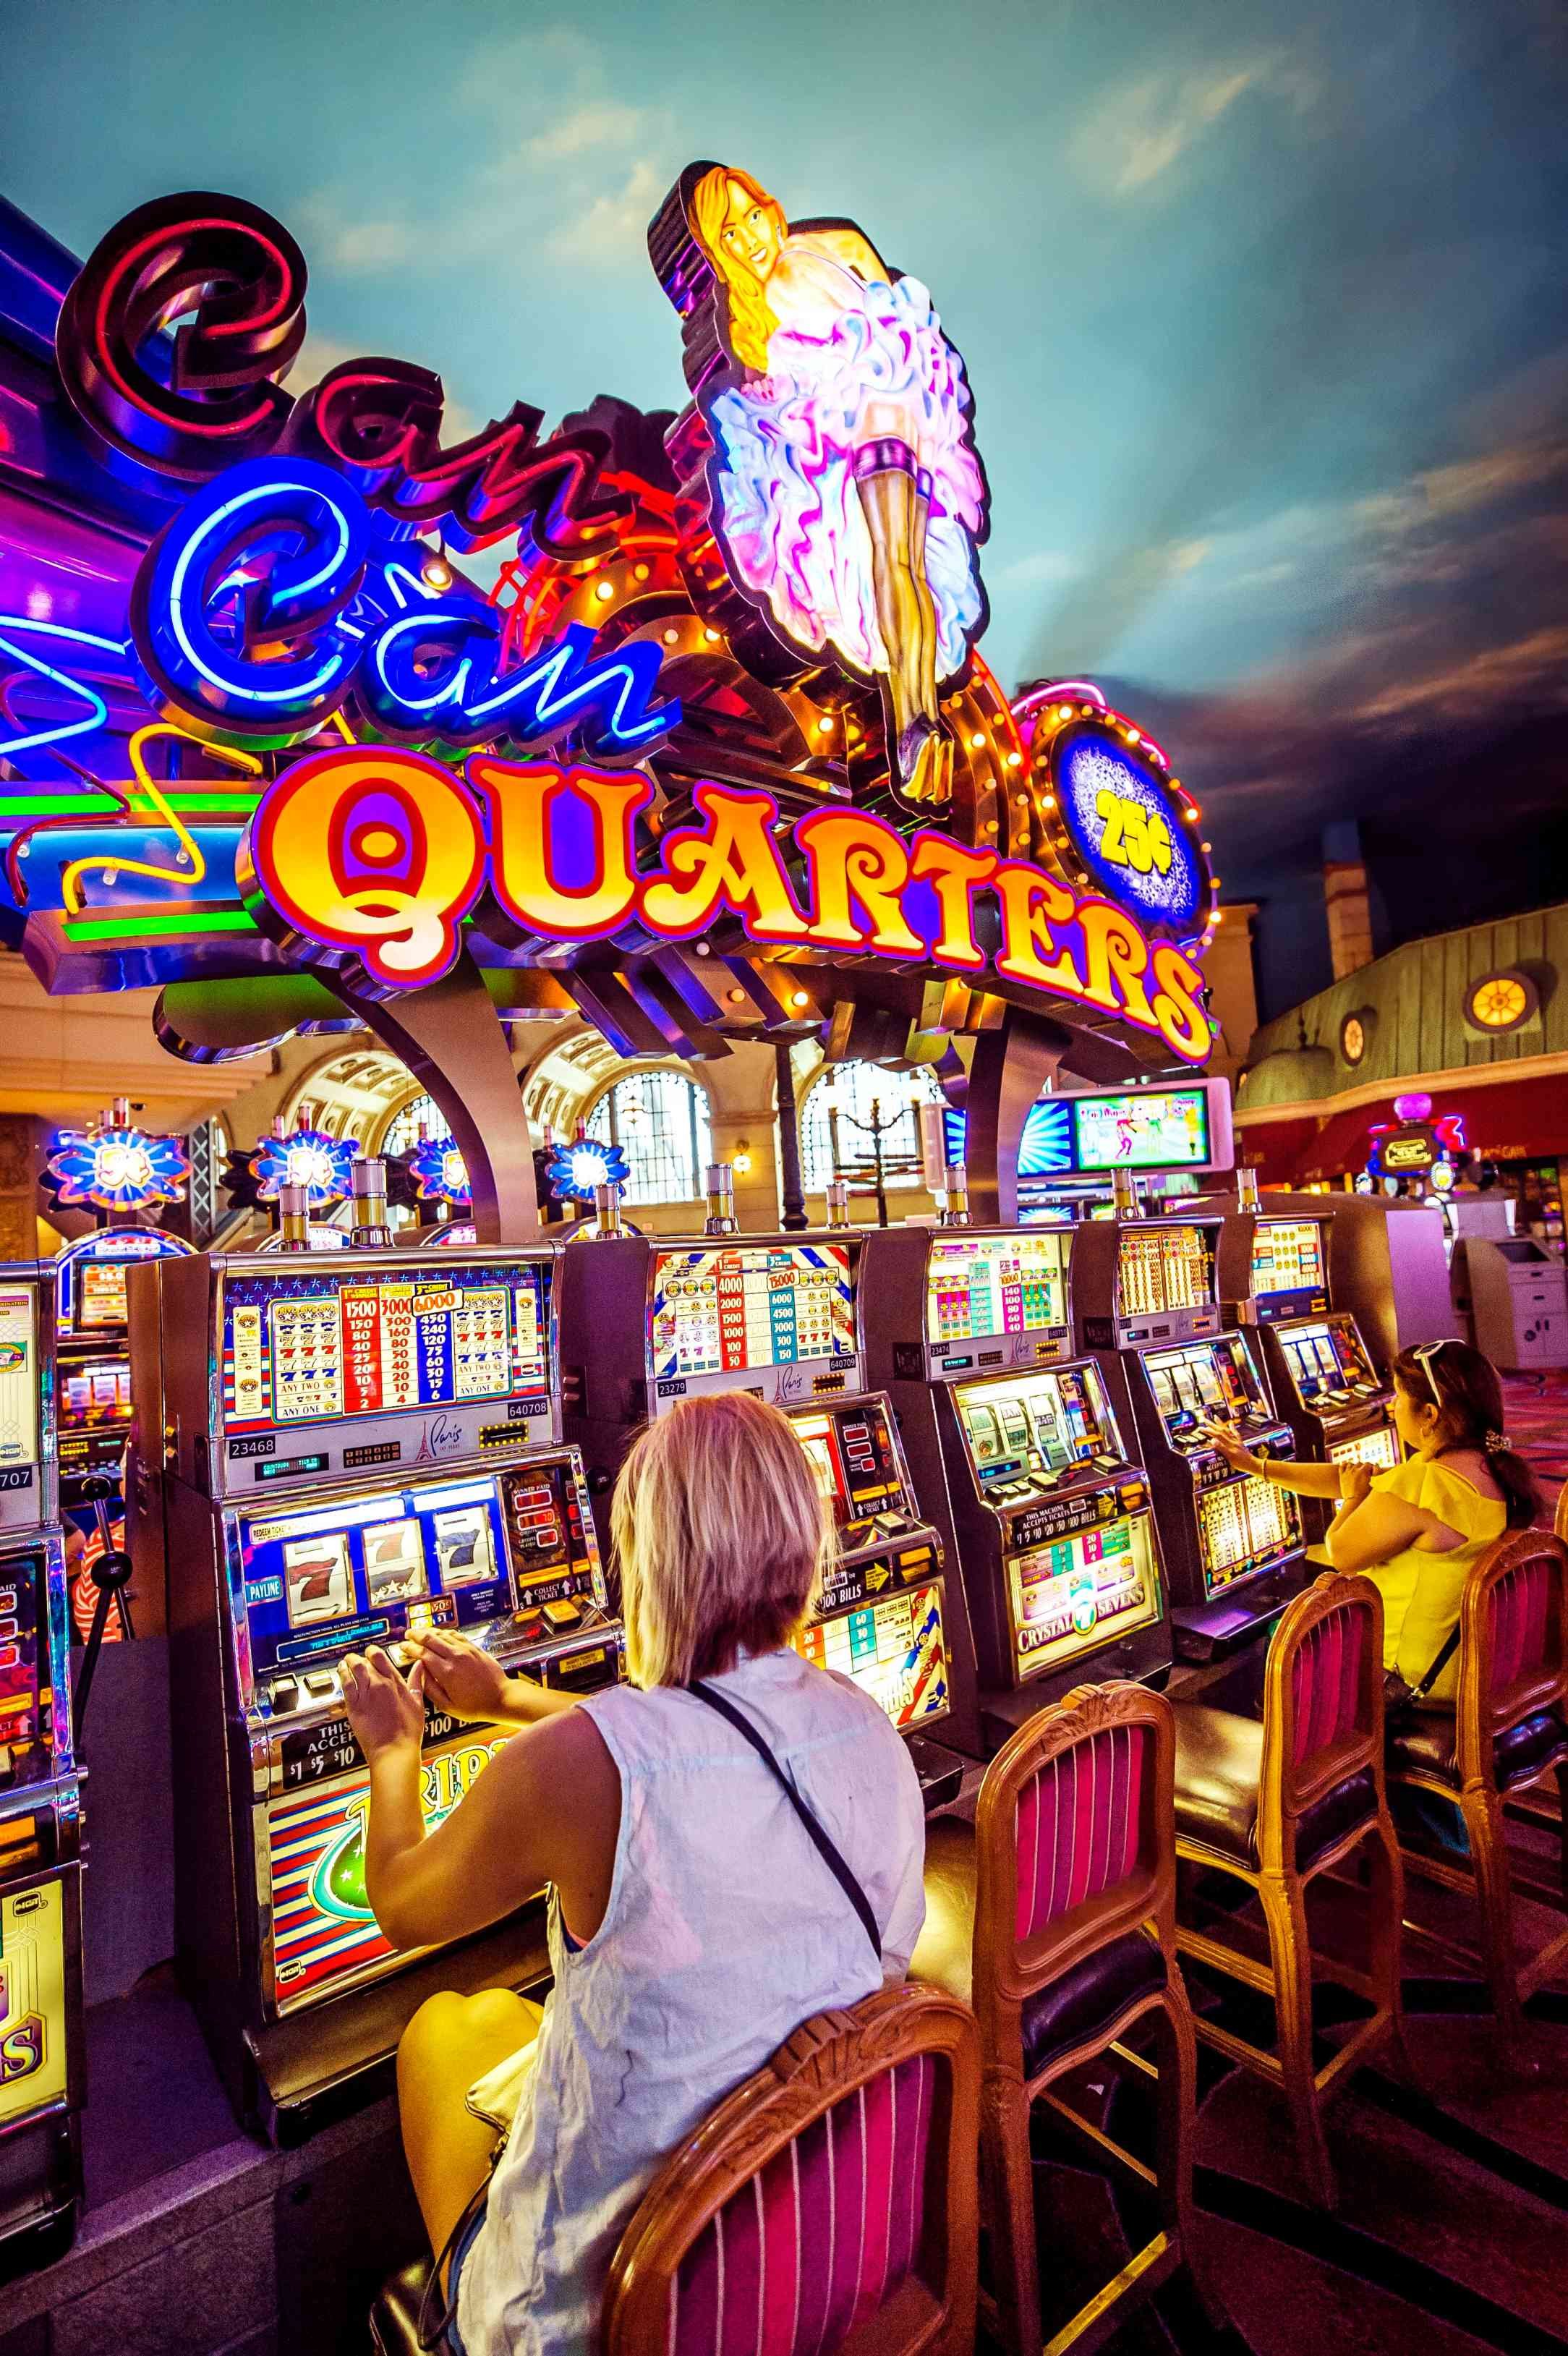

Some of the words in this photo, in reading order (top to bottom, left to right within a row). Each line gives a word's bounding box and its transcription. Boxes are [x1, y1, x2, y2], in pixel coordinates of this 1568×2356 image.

[56, 190, 636, 561] Can
[130, 456, 682, 752] Can
[1096, 788, 1172, 875] 25¢
[262, 749, 1211, 1063] QUARTERS
[719, 1277, 742, 1293] 4000
[414, 1293, 455, 1312] 6,000
[720, 1298, 741, 1309] 2000
[772, 1293, 792, 1304] 6000
[346, 1301, 377, 1317] 1500
[773, 1308, 793, 1318] 4500
[386, 1317, 412, 1326] 300
[420, 1314, 446, 1324] 450
[722, 1313, 741, 1323] 1500
[349, 1319, 373, 1330] 150
[422, 1324, 446, 1335] 240
[774, 1322, 793, 1332] 3000
[353, 1331, 370, 1340] 80
[388, 1327, 410, 1337] 160
[723, 1327, 743, 1338] 1000
[391, 1338, 408, 1348] 80
[423, 1335, 446, 1345] 120
[777, 1337, 791, 1345] 300
[352, 1342, 370, 1352] 40
[426, 1346, 443, 1356] 75
[726, 1342, 741, 1352] 100
[354, 1353, 370, 1364] 25
[393, 1350, 409, 1358] 50
[779, 1350, 791, 1359] 150
[392, 1361, 409, 1370] 40
[426, 1356, 443, 1367] 60
[729, 1356, 739, 1366] 50
[830, 1357, 856, 1369] 640709
[354, 1364, 372, 1374] 20
[427, 1368, 443, 1379] 30
[355, 1375, 372, 1385] 10
[393, 1372, 409, 1381] 20
[281, 1385, 298, 1393] ANY
[300, 1382, 319, 1391] TWO
[394, 1383, 409, 1392] 10
[428, 1379, 443, 1389] 15
[461, 1385, 475, 1394] ANY
[477, 1383, 491, 1392] ONE
[783, 1366, 803, 1400] Paris
[360, 1387, 368, 1397] 5
[431, 1390, 440, 1400] 6
[659, 1384, 686, 1395] 23279
[360, 1399, 369, 1408] 2
[397, 1395, 406, 1403] 4
[283, 1407, 301, 1416] ANY
[303, 1405, 320, 1413] ONE
[510, 1402, 547, 1416] 640708
[430, 1414, 462, 1456] Paris
[231, 1439, 274, 1456] 23468
[1039, 1505, 1065, 1517] MACHINE
[1023, 1516, 1048, 1529] ACCEPTS
[1049, 1509, 1070, 1521] TICKETS
[1081, 1510, 1096, 1524] BILLS
[253, 1528, 270, 1537] REDEEM
[1086, 1534, 1096, 1544] 20
[1088, 1543, 1097, 1553] 10
[250, 1581, 280, 1599] PAYLINE
[534, 1583, 560, 1596] COLLECT
[840, 1584, 861, 1603] BILLS
[539, 1591, 558, 1602] TICKET
[856, 1614, 866, 1624] 60
[1018, 1612, 1073, 1652] CRYSTAL
[1097, 1582, 1145, 1617] SEVENS
[804, 1633, 814, 1643] 20
[319, 1722, 351, 1737] THIS
[425, 1716, 452, 1738] $100
[290, 1761, 302, 1781] $1
[311, 1755, 325, 1774] $5
[334, 1746, 354, 1766] $10
